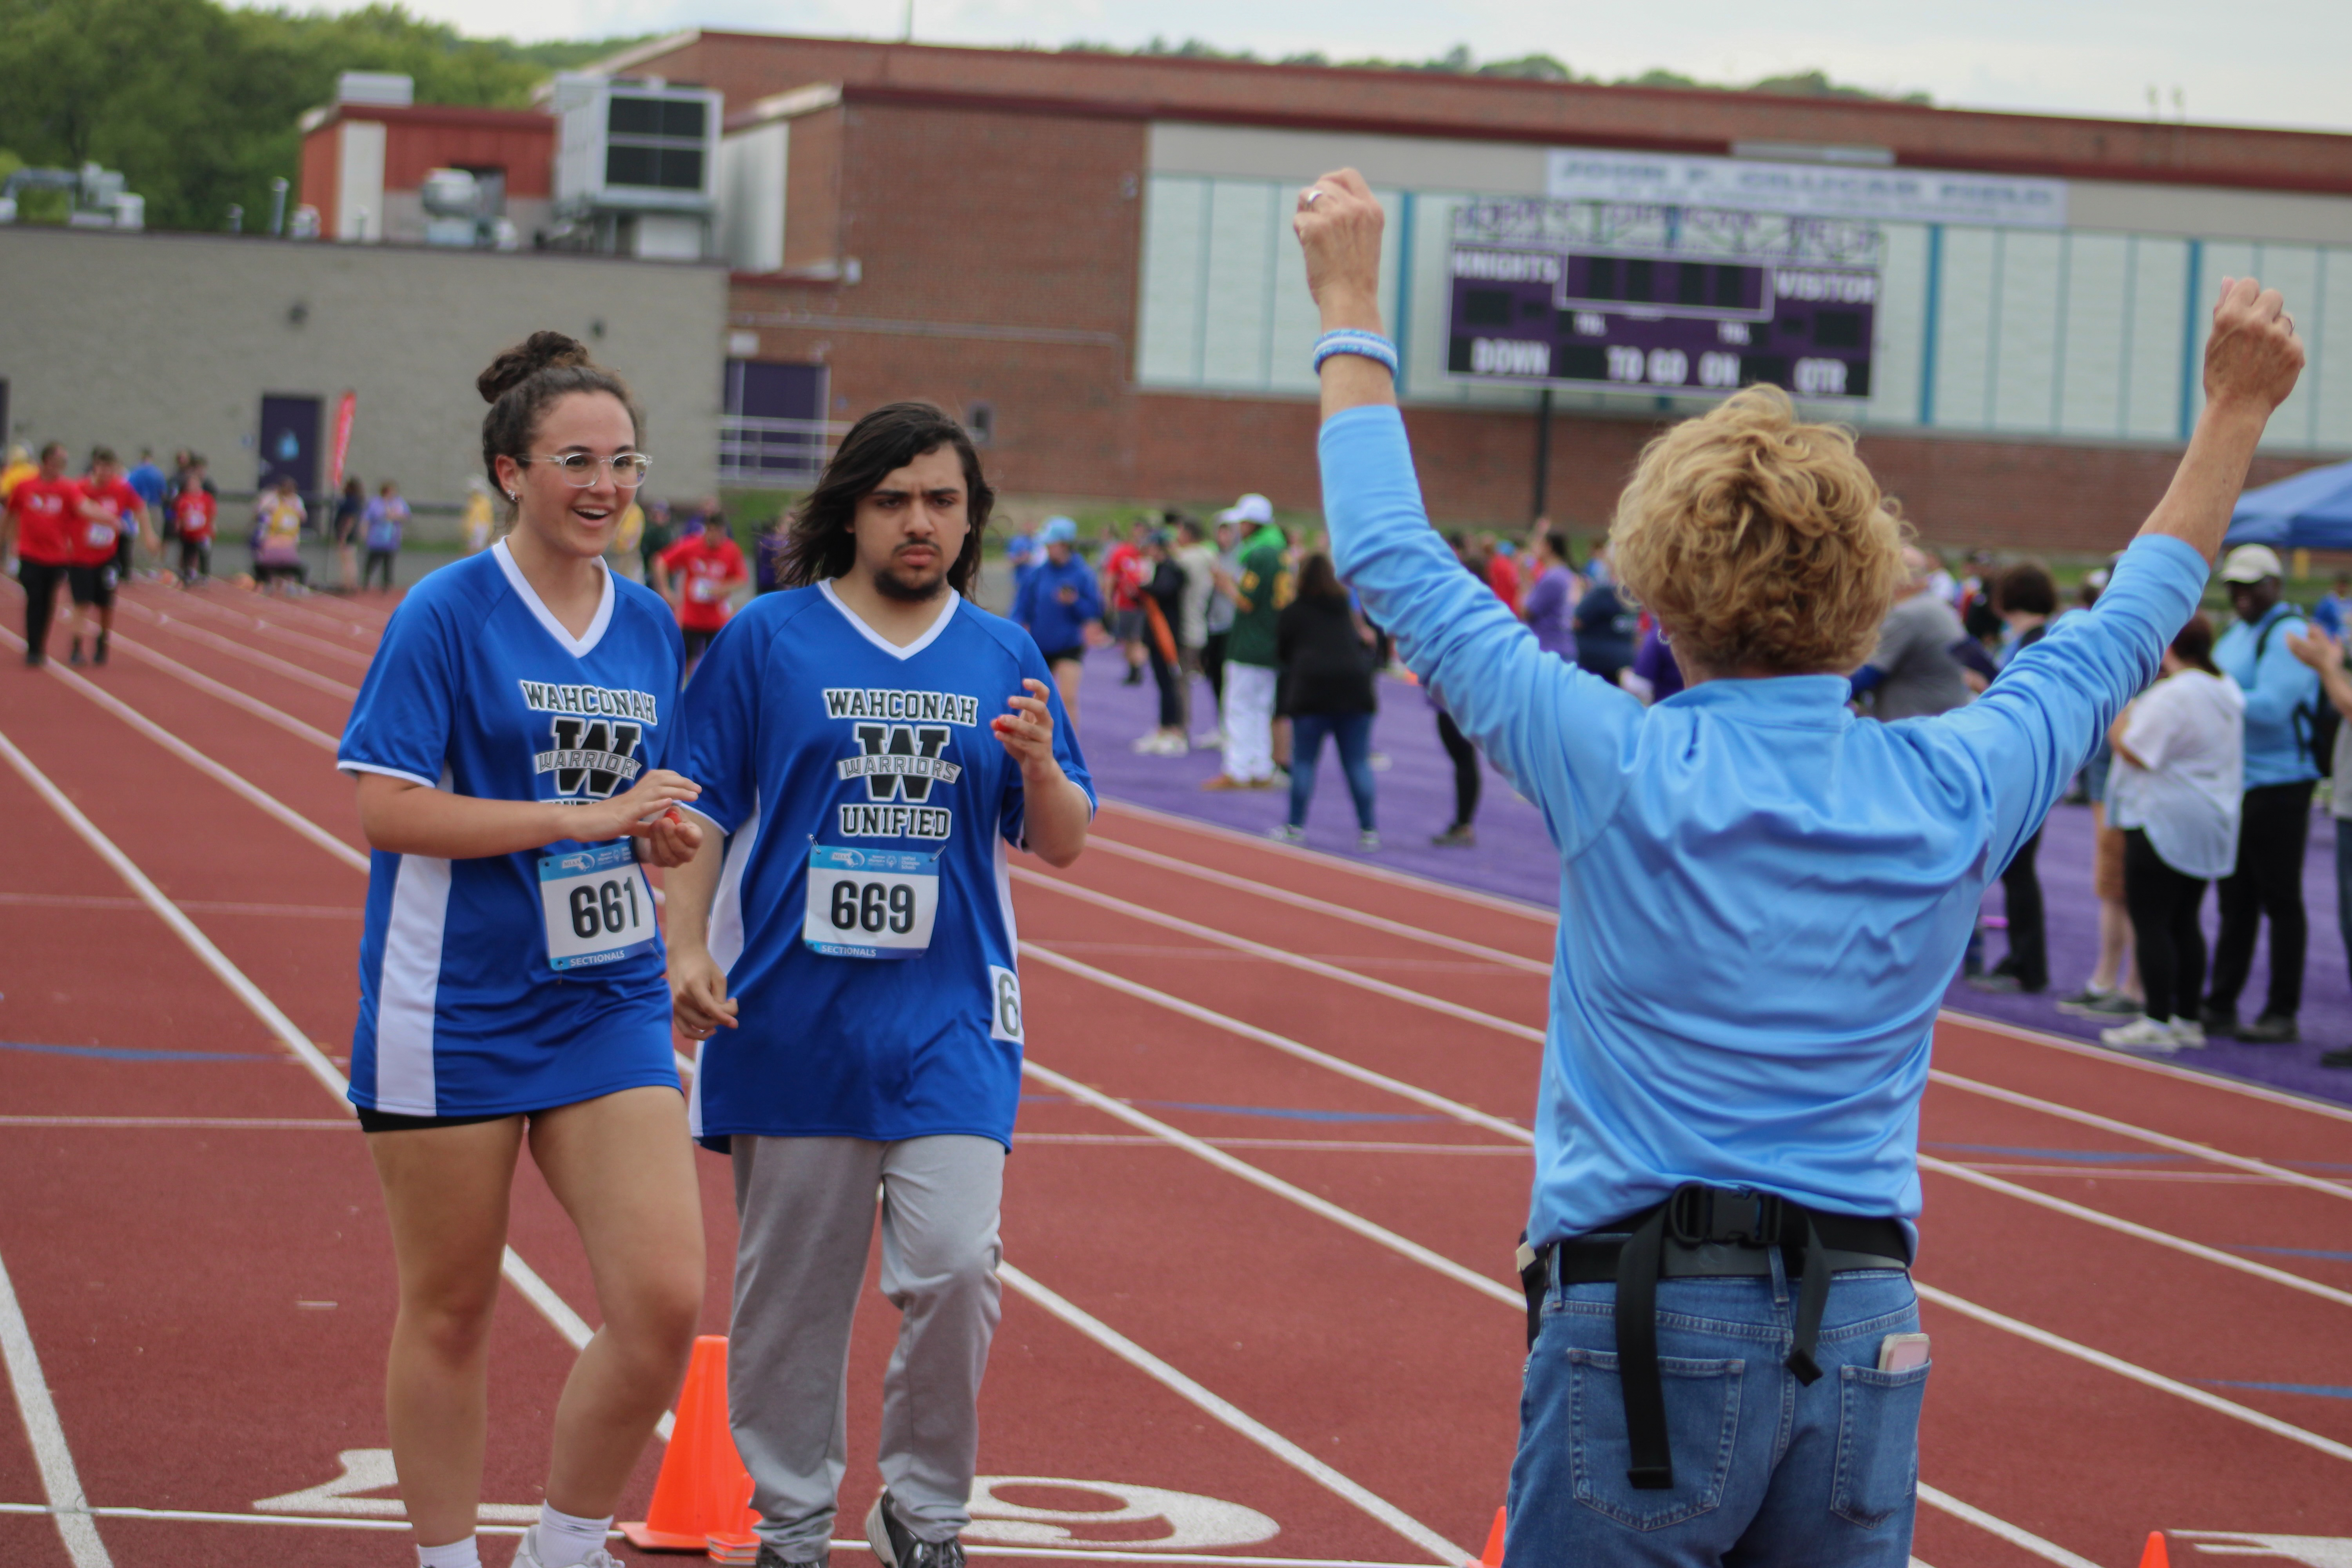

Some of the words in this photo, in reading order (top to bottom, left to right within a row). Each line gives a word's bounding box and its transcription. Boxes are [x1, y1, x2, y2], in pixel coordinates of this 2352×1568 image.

[1454, 250, 1561, 283] KNIGHTS
[1776, 272, 1876, 303] VISITOR
[1472, 336, 1551, 376] DOWN
[1606, 345, 1646, 383] TO
[1647, 347, 1688, 385] GO
[1698, 351, 1740, 387] ON
[1793, 357, 1848, 393] QTR
[519, 679, 658, 725] WAHCONAH
[822, 688, 978, 727] WAHCONAH
[844, 756, 956, 781] WARRIORS
[838, 804, 953, 840] UNIFIED
[570, 876, 641, 939] 661
[831, 880, 916, 934] 669
[570, 950, 625, 967] SECTIONALS
[822, 945, 877, 957] SECTIONALS
